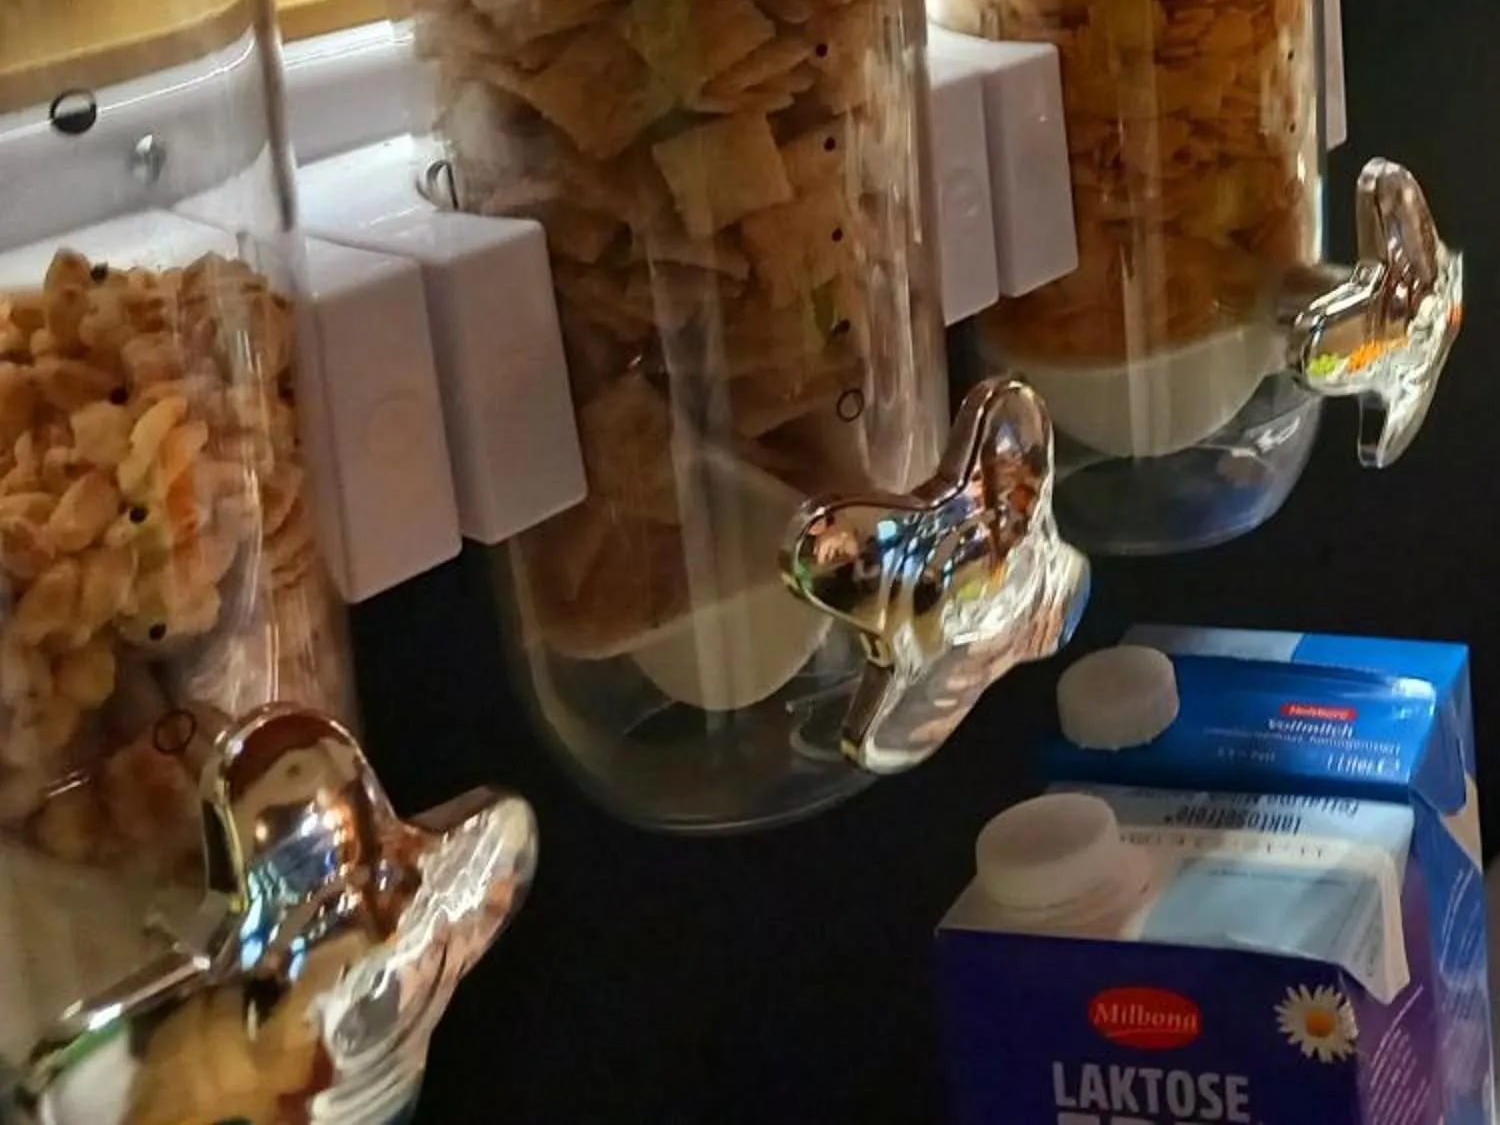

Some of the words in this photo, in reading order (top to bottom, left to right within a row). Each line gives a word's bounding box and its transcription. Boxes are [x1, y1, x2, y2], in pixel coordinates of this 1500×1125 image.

[1267, 718, 1354, 739] Vollmilch
[1093, 1001, 1198, 1032] Milbona
[1052, 1060, 1251, 1124] LAKTOSE
